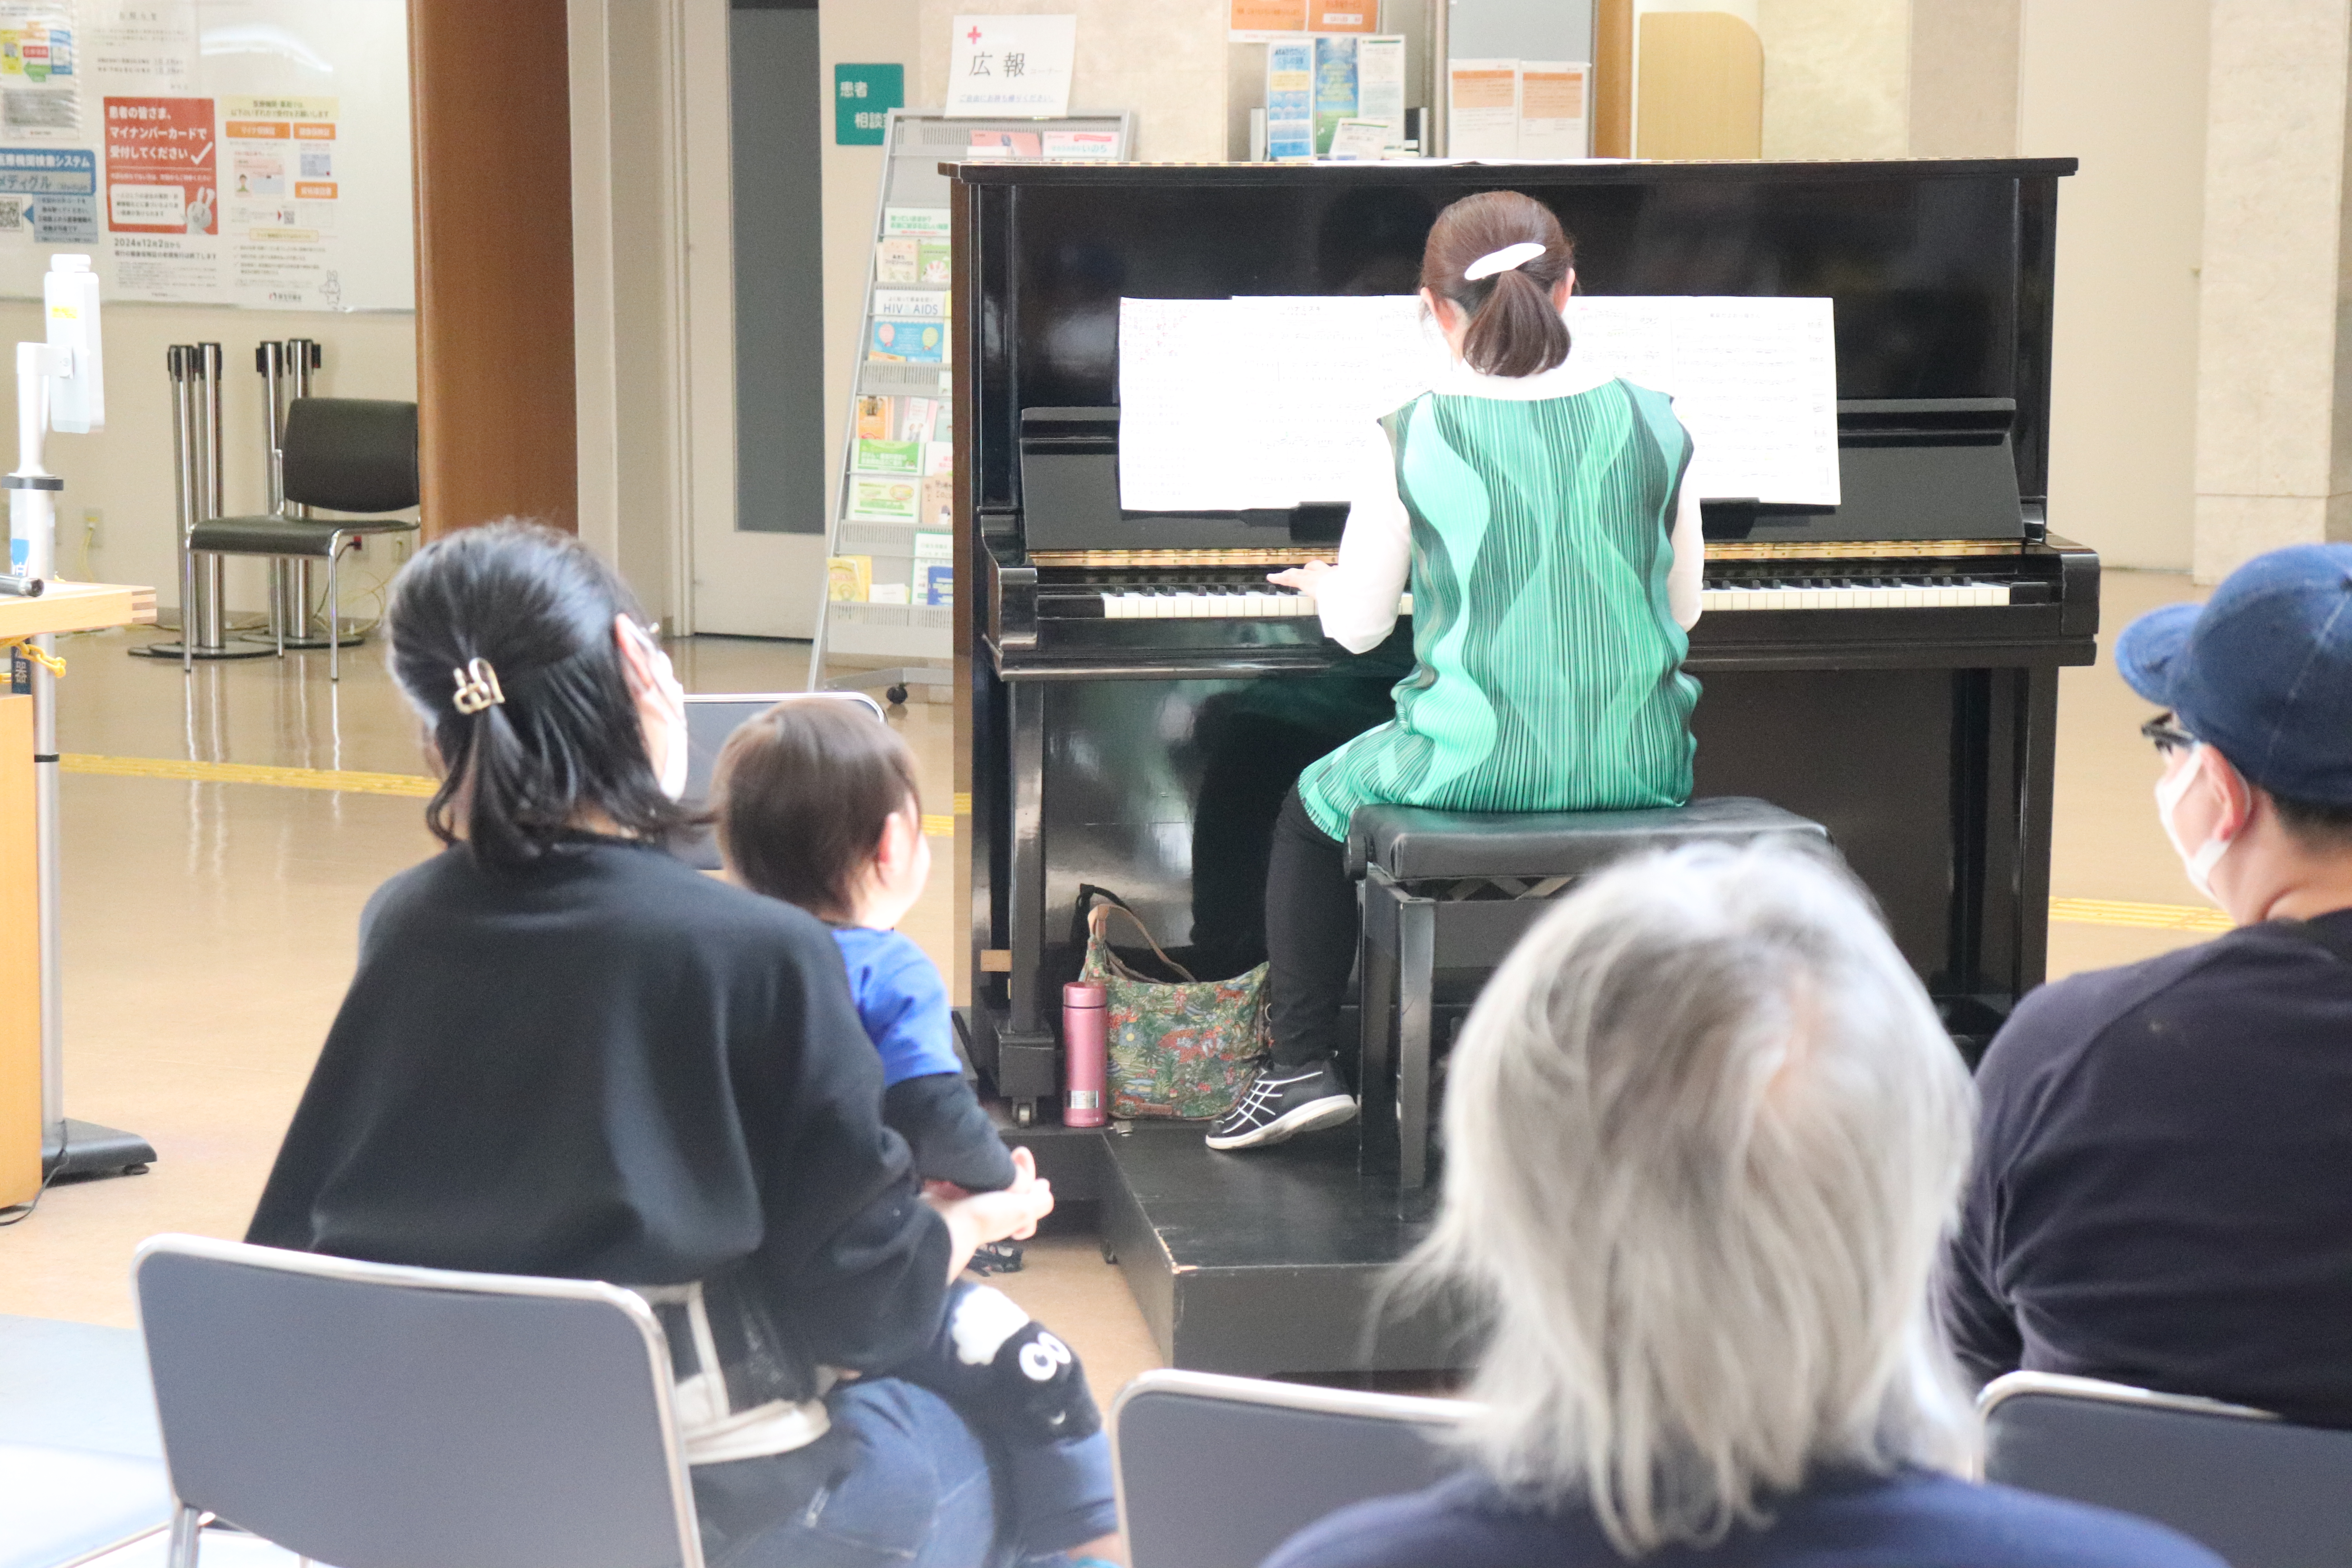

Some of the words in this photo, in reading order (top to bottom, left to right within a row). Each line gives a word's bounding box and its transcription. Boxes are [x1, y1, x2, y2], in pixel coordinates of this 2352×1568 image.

[840, 82, 867, 98] 患者
[110, 126, 207, 140] マイナンバーカードで
[884, 304, 903, 314] HIV
[913, 304, 938, 314] AIDS
